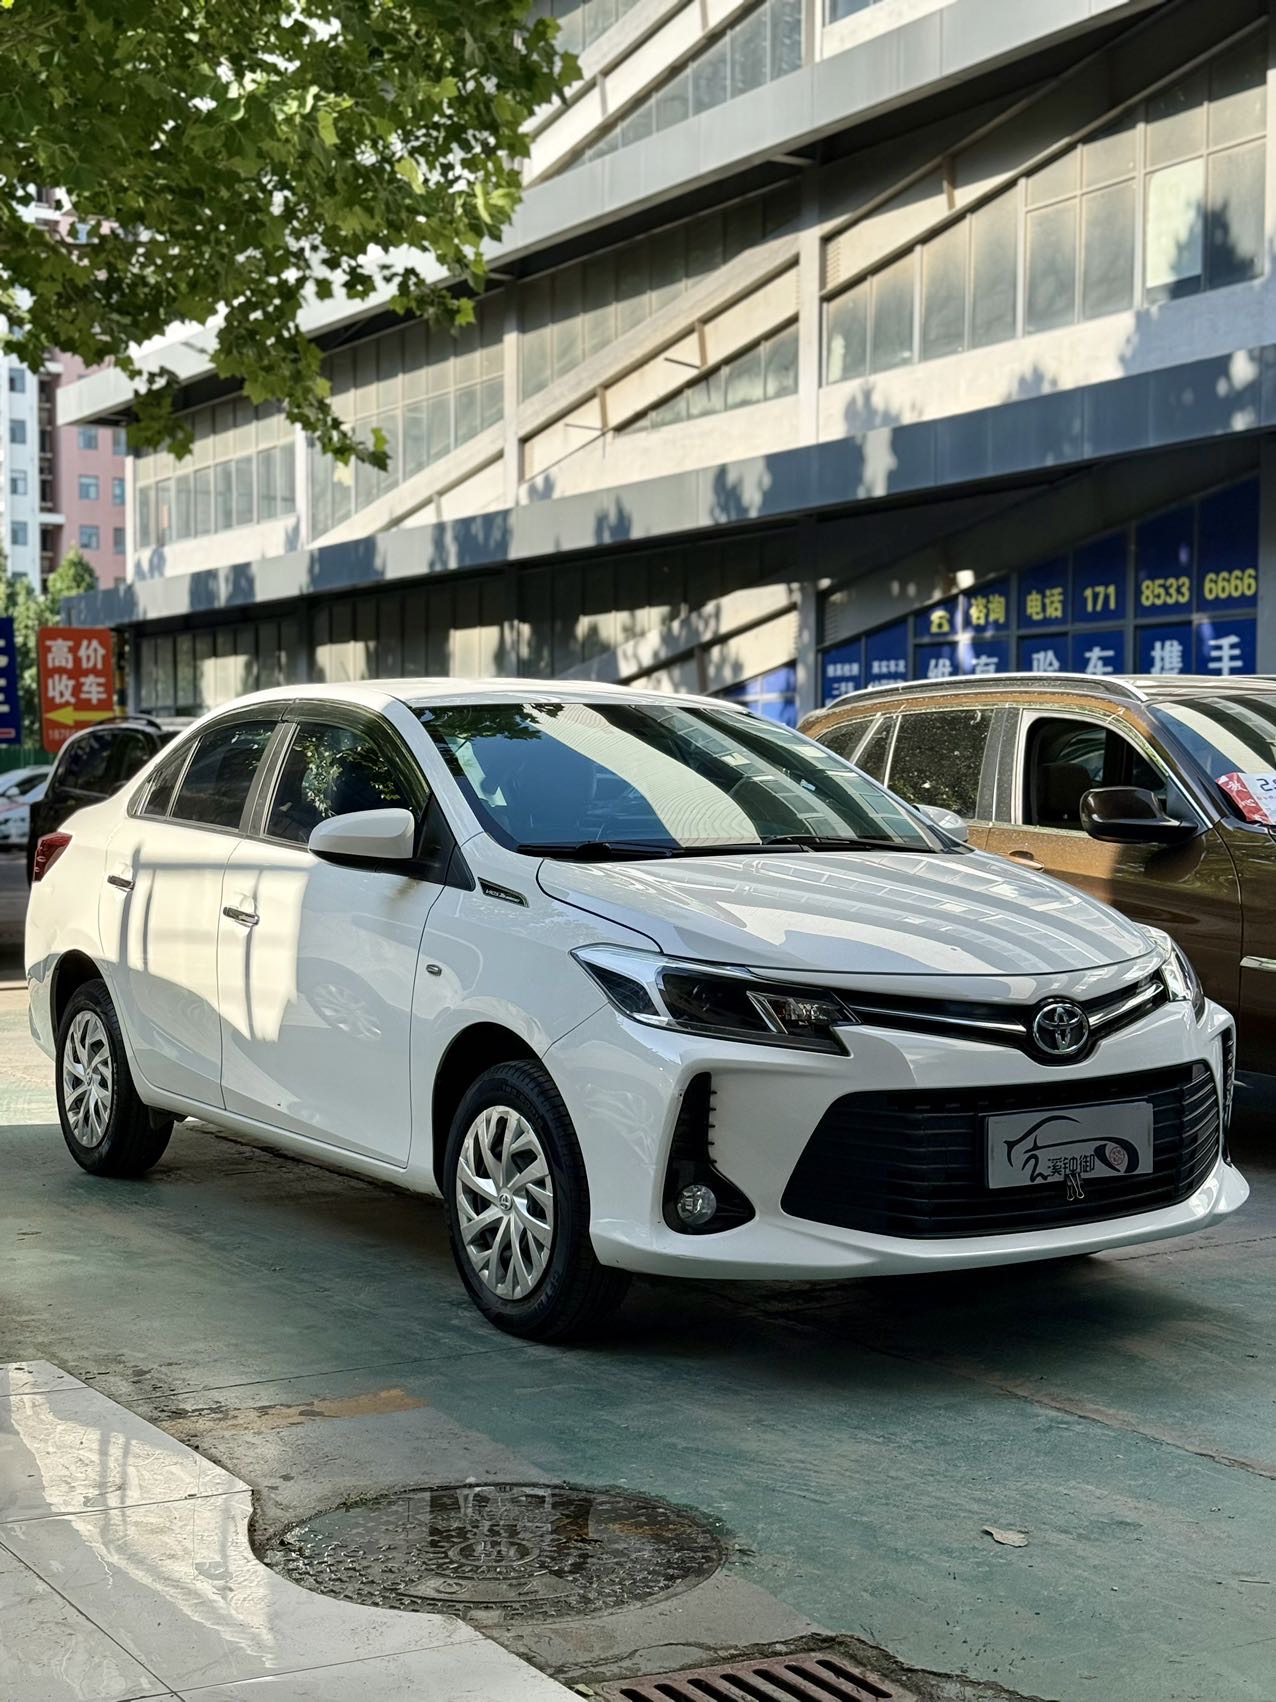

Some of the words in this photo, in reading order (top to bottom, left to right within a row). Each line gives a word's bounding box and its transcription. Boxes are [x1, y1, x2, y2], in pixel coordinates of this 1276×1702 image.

[969, 594, 1006, 626] 咨询
[1026, 587, 1064, 620] 电话
[1083, 584, 1116, 613] 171
[1140, 576, 1190, 607] 8533
[1203, 567, 1257, 601] 6666
[45, 638, 106, 671] 高价
[47, 674, 108, 705] 收车
[1256, 777, 1276, 792] 2
